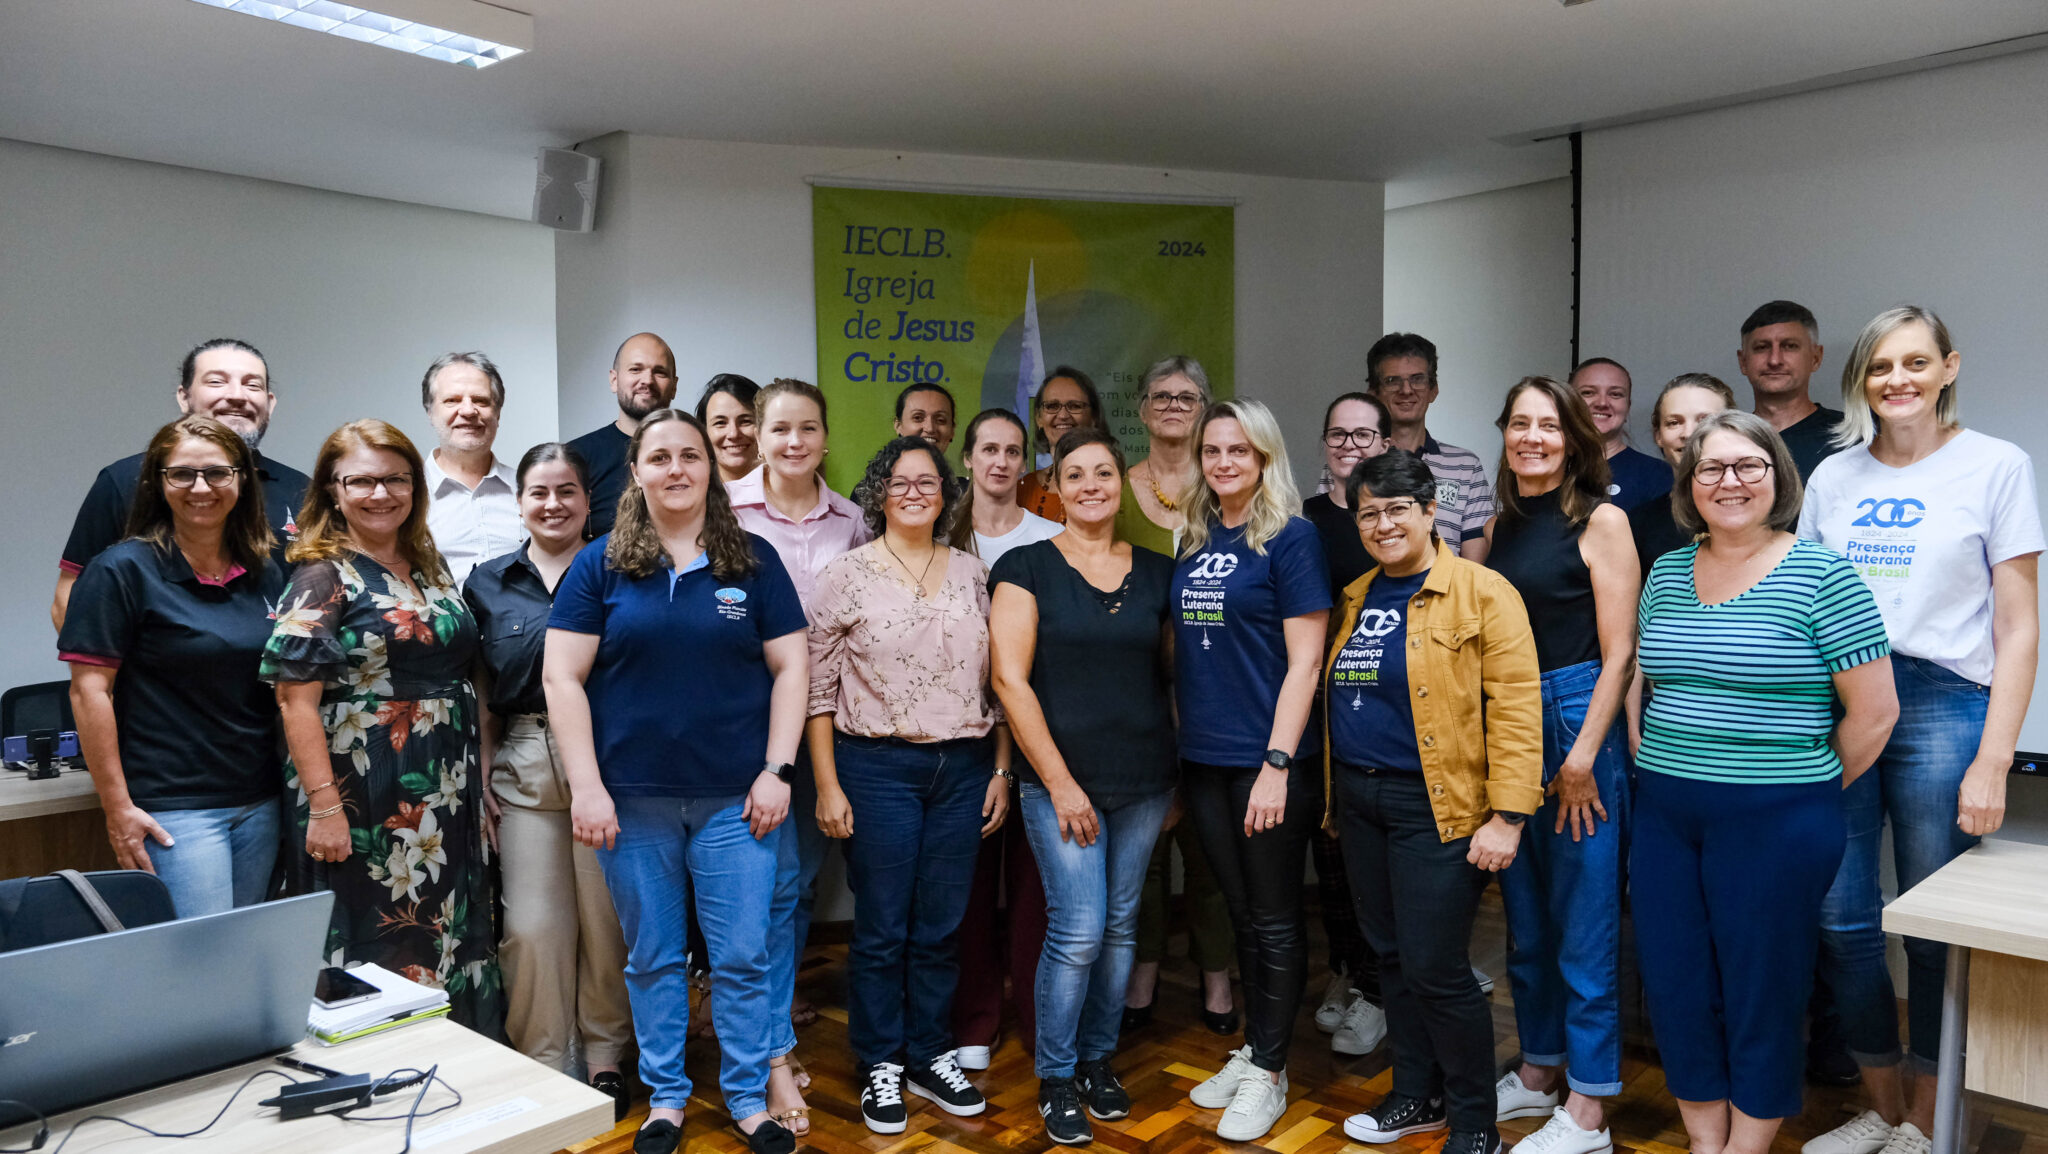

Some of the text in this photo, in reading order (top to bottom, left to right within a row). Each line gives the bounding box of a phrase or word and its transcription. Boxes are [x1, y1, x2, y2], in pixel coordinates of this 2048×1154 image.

[842, 225, 951, 258] IECLB.
[1158, 240, 1206, 256] 2024
[843, 267, 935, 305] Igreja
[844, 309, 975, 342] de Jesus
[844, 351, 951, 383] Cristo.
[1111, 408, 1139, 417] dias
[1120, 425, 1144, 435] dos
[1124, 445, 1151, 453] Mate
[1851, 497, 1926, 528] 200
[1847, 541, 1916, 556] Presença
[1846, 552, 1912, 565] Luterana
[1187, 552, 1239, 579] 200
[1868, 566, 1910, 578] Brasil
[1181, 589, 1225, 602] Presença
[1181, 599, 1224, 611] Luterana
[1183, 610, 1225, 622] no Brasil
[1340, 648, 1384, 660] Presença
[1335, 660, 1381, 669] Luterana
[1334, 669, 1378, 681] no Brasil
